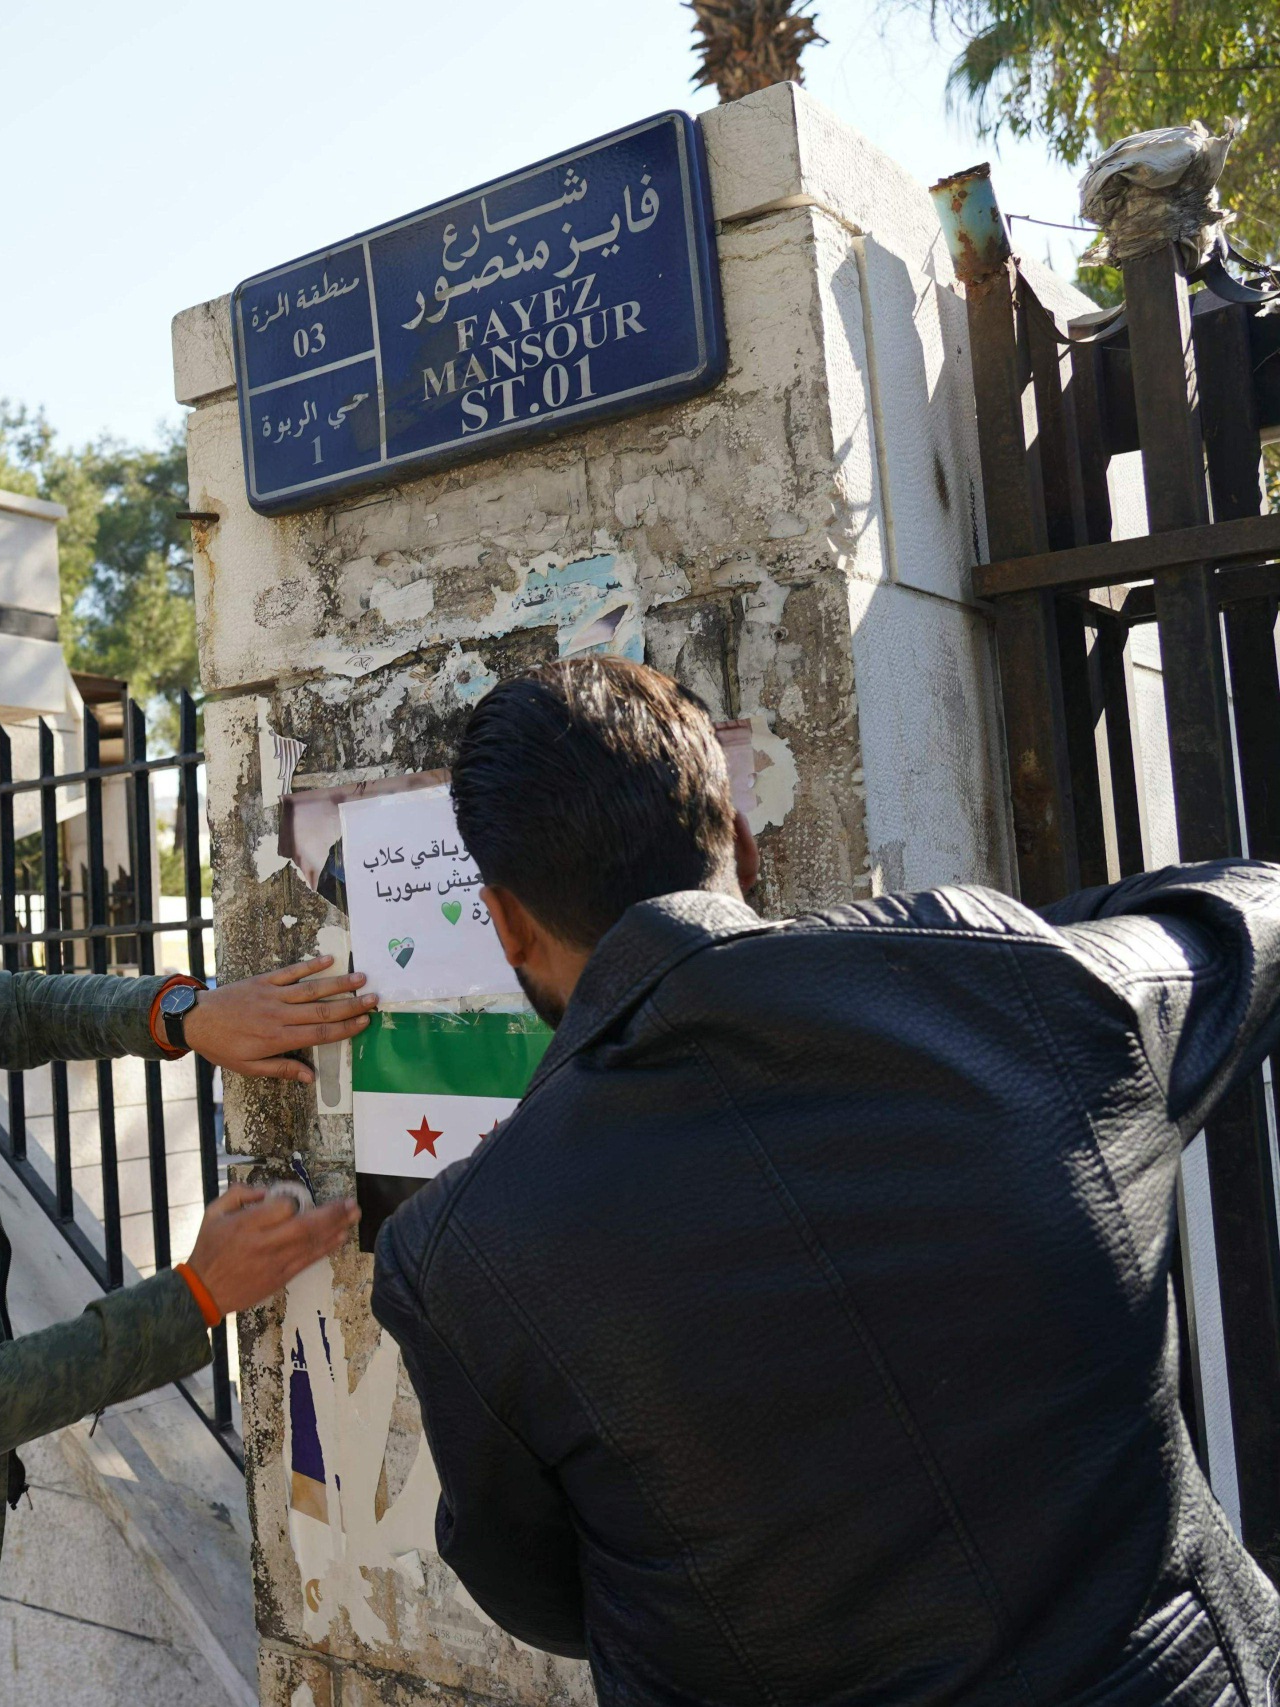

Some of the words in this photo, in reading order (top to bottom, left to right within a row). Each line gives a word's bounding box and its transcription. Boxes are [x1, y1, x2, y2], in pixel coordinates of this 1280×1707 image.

[442, 168, 589, 272] شارع
[553, 173, 661, 279] فايز
[295, 271, 361, 310] منطقة
[401, 234, 550, 330] منصور
[251, 291, 291, 333] المزة
[453, 272, 601, 354] FAYEZ
[293, 322, 327, 358] 03
[422, 300, 648, 402] MANSOUR
[327, 392, 370, 430] حي
[460, 353, 598, 435] ST.01
[261, 399, 319, 444] الربوة
[310, 434, 326, 466] 1
[363, 846, 406, 873] كلاب
[376, 880, 432, 903] سوريا
